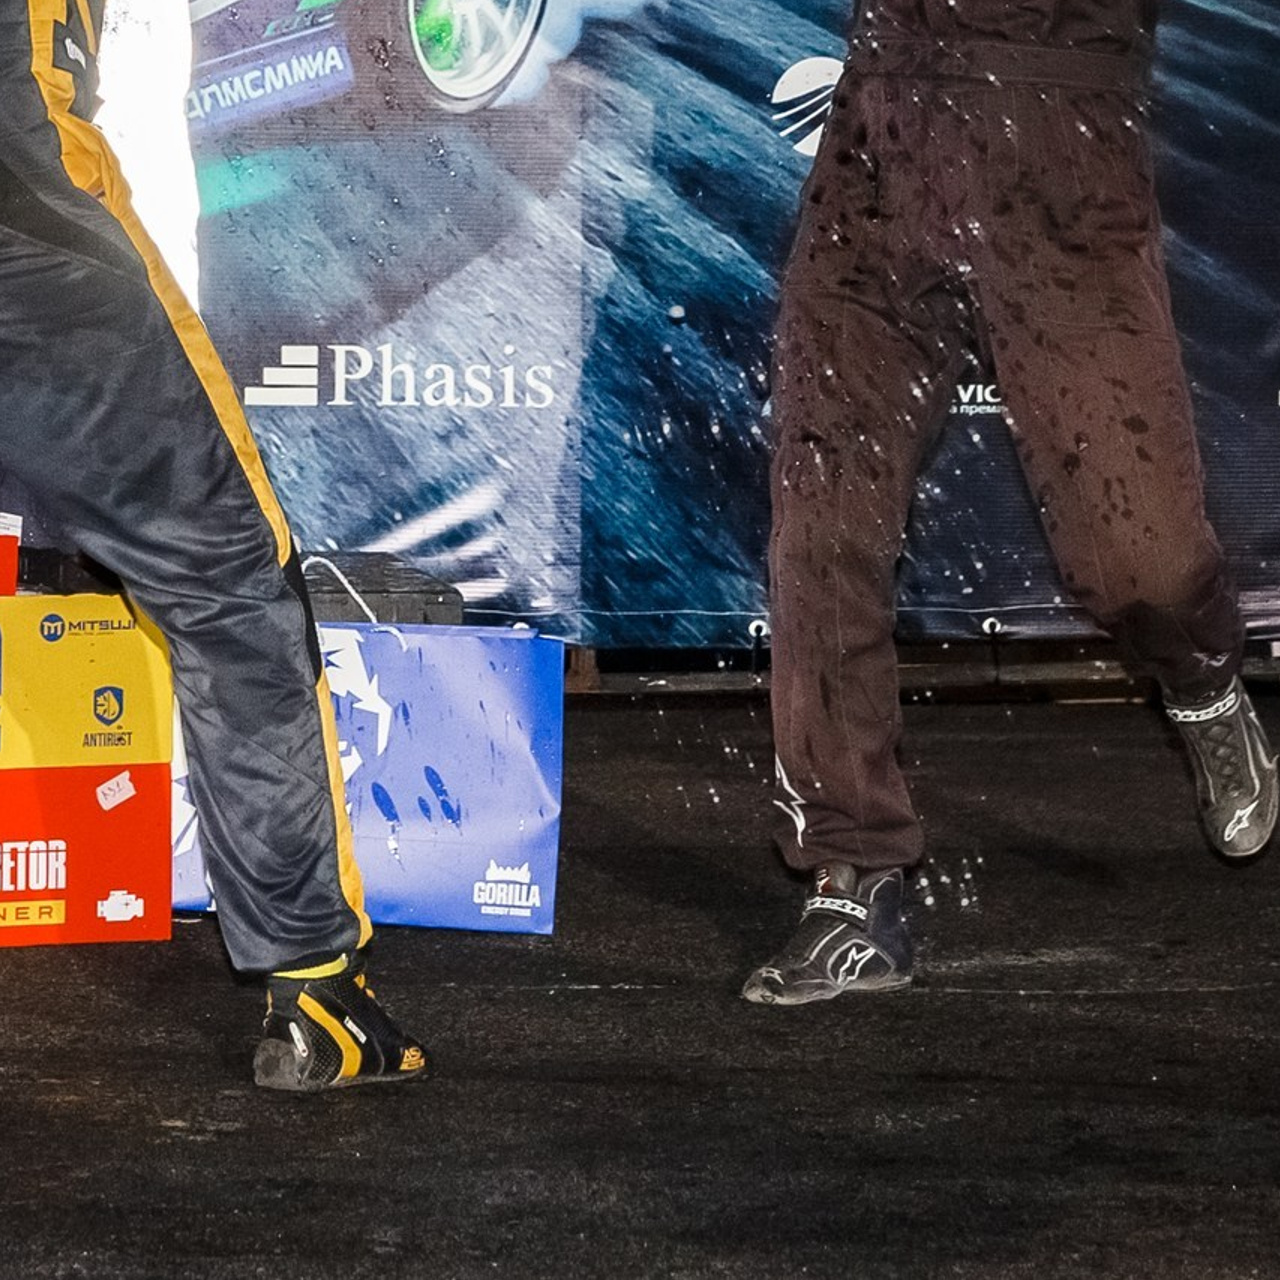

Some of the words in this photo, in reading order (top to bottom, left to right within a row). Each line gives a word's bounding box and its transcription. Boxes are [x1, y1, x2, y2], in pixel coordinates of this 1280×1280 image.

[326, 343, 555, 408] Phasis
[68, 619, 136, 631] MITSUJI
[82, 731, 133, 748] ANTIRUST
[473, 881, 541, 908] GORILLA
